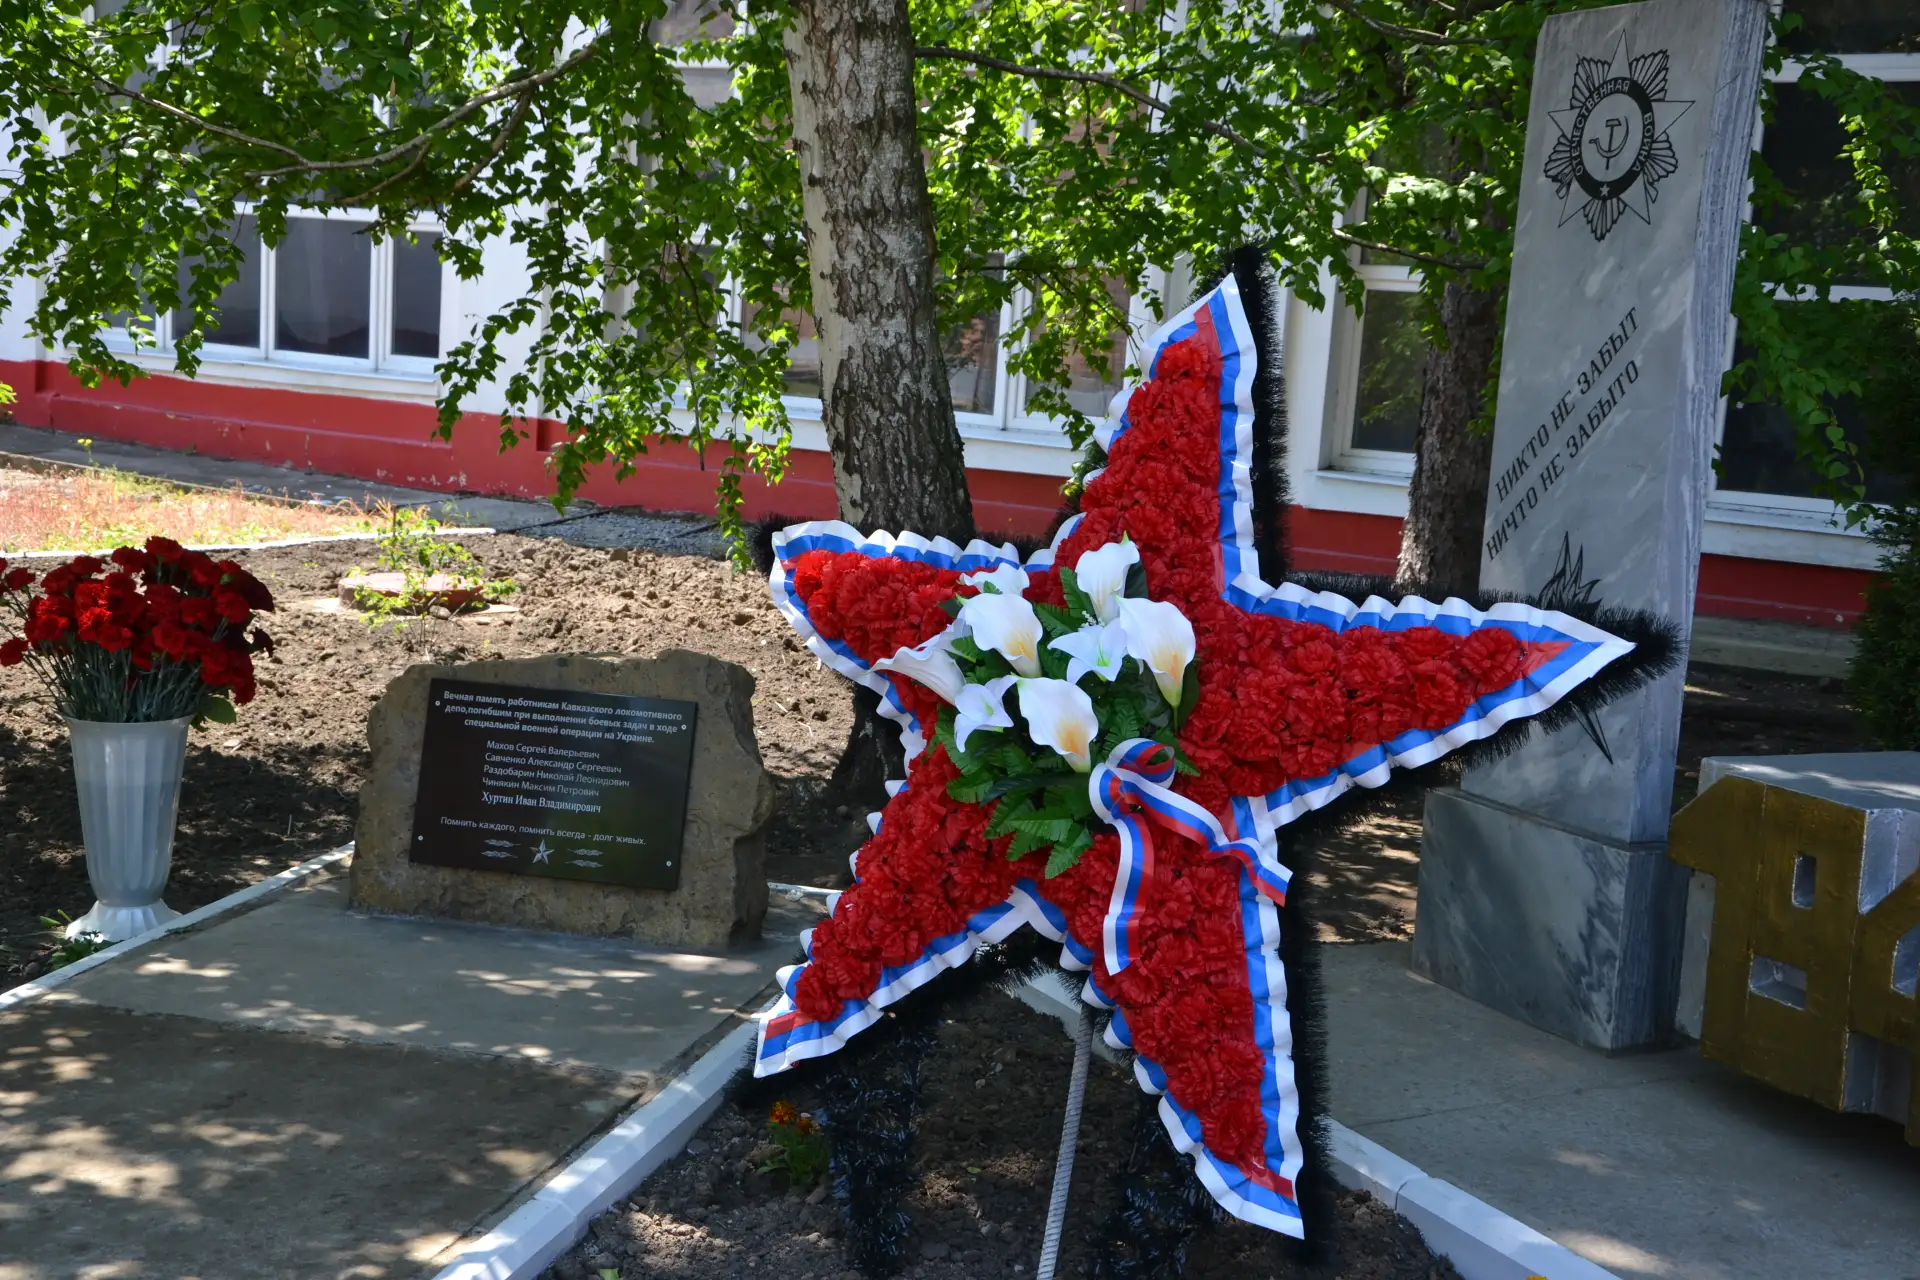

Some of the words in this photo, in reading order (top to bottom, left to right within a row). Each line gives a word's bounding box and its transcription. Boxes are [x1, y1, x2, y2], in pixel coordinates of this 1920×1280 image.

[1571, 80, 1630, 176] ОТЕЧЕСТВЕННАЯ
[1495, 423, 1551, 503] НИКТО
[1550, 390, 1577, 432] НЕ
[1577, 307, 1640, 396] ЗАБЫТ
[1485, 486, 1539, 562] НИЧТО
[1540, 454, 1565, 492] НЕ
[1565, 360, 1640, 459] ЗАБЫТО
[444, 690, 474, 701] Вечная
[476, 695, 506, 704] память
[508, 697, 559, 709] работникам
[561, 701, 613, 714] Кавказского
[615, 708, 682, 720] локомотивного
[464, 719, 520, 731] специальной
[521, 724, 558, 734] военной
[560, 728, 602, 739] операции
[514, 711, 530, 720] при
[532, 713, 586, 724] выполнении
[588, 716, 621, 727] боевых
[622, 722, 647, 731] задач
[656, 724, 678, 734] ходе
[486, 740, 514, 751] Махов
[516, 743, 546, 754] Сергей
[548, 747, 600, 759] Валерьевич
[485, 752, 526, 764] Савченко
[527, 757, 574, 771] Александр
[576, 762, 622, 774] Сергеевич
[482, 777, 519, 789] Чинякин
[521, 781, 555, 792] Максим
[557, 785, 599, 797] Петрович
[483, 765, 534, 778] Раздобарин
[536, 770, 574, 782] Николай
[575, 774, 630, 787] Леонидович
[481, 791, 514, 805] Хуртин
[515, 795, 537, 807] Иван
[539, 797, 602, 813] Владимирович
[440, 816, 478, 828] Помнить
[479, 821, 517, 833] каждого,
[518, 826, 555, 837] помнить
[557, 830, 586, 840] всегда
[593, 833, 614, 843] долг
